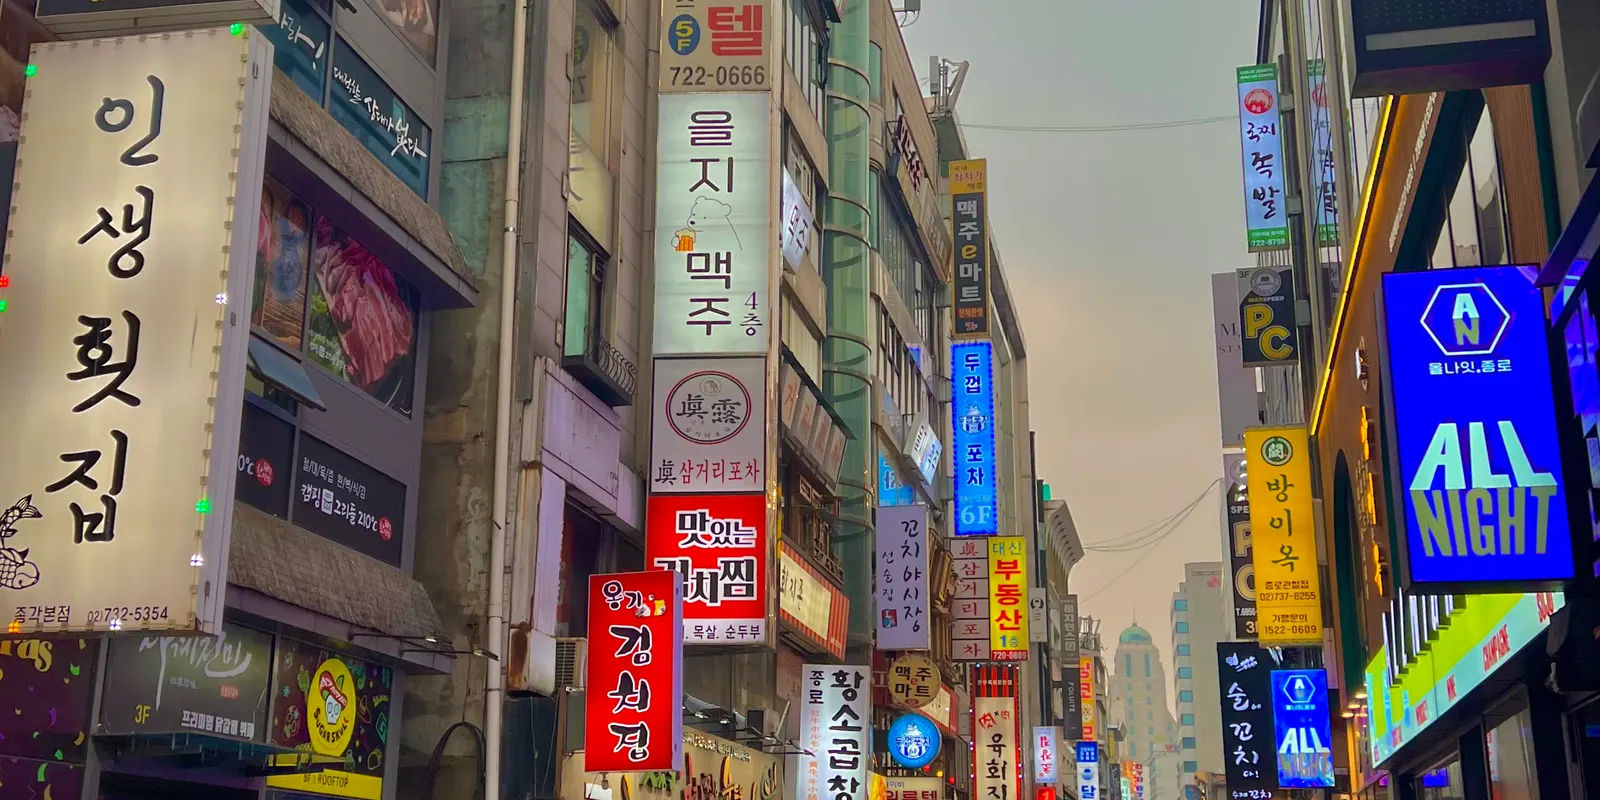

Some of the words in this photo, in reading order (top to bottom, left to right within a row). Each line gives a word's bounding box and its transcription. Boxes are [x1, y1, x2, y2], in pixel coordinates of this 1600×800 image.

[674, 20, 694, 52] 5F
[707, 4, 763, 57] 텔
[669, 65, 765, 86] 722-0666
[687, 110, 735, 193] 을지
[956, 199, 983, 303] 맥주e마트
[1238, 270, 1250, 279] 3F
[686, 251, 732, 336] 맥주
[45, 73, 165, 544] 인생횟집
[739, 290, 763, 337] 4층
[1243, 303, 1293, 361] PC
[964, 352, 982, 395] 두껍
[1428, 359, 1512, 375] 올나잇.종로
[966, 443, 985, 487] 포차
[1409, 420, 1558, 491] ALL
[679, 457, 760, 485] 삼거리포차
[675, 508, 758, 549] 맛있는
[960, 505, 992, 525] 6F
[1409, 485, 1558, 558] NIGHT
[992, 541, 1022, 556] 대신
[601, 580, 644, 611] 옹기
[960, 562, 981, 657] 삼거리포차
[994, 559, 1023, 632] 부동산
[1259, 591, 1317, 602] 02)737-8255
[14, 605, 72, 624] 종각본점
[87, 605, 169, 623] 02)732-5354
[724, 623, 761, 640] 순두부
[999, 635, 1021, 648] 1층
[1264, 624, 1318, 635] 1522-0609
[808, 670, 826, 705] 종로
[894, 666, 932, 682] 맥주
[894, 683, 932, 698] 마트
[134, 704, 152, 725] 3F
[180, 710, 214, 732] 프리미엄
[826, 669, 865, 800] 황소곱창
[1278, 727, 1331, 753] ALL
[1278, 752, 1331, 778] NIGHT
[317, 774, 349, 788] ROOFTOP
